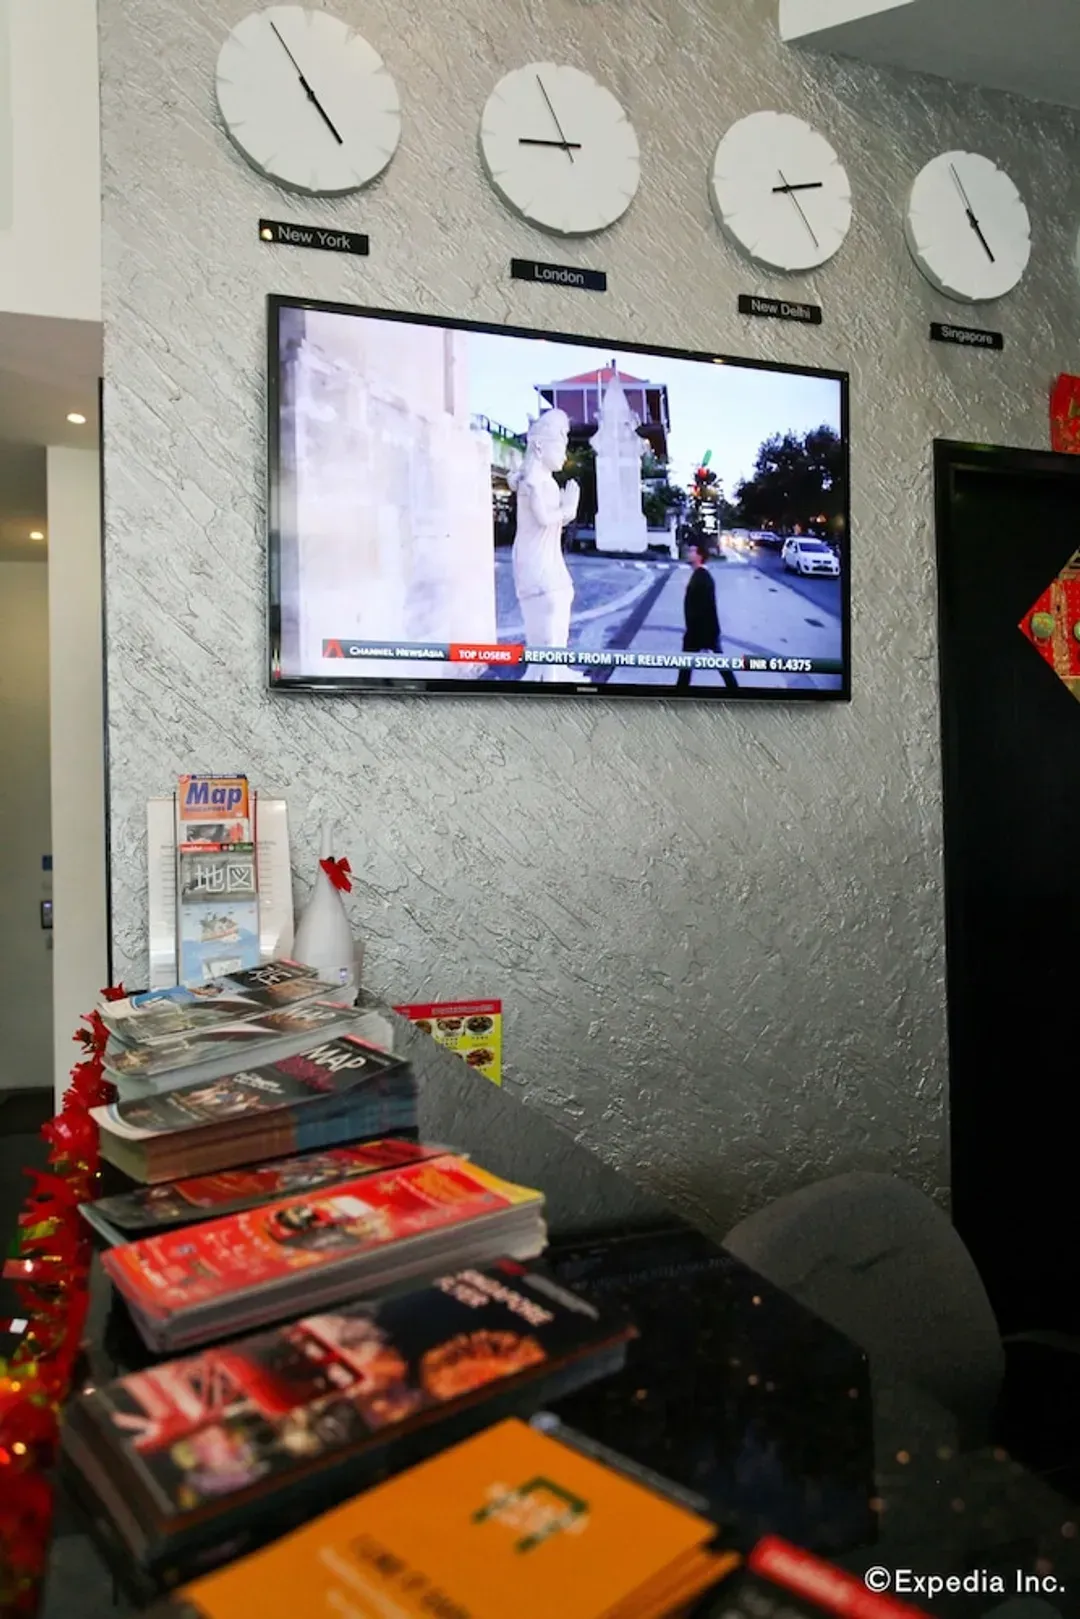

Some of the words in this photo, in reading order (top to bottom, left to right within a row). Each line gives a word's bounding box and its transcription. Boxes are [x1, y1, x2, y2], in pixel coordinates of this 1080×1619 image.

[278, 225, 313, 243] New
[317, 231, 351, 249] York
[534, 265, 584, 285] London
[751, 299, 778, 314] New
[781, 304, 811, 320] Delhi
[941, 325, 993, 345] Singapore
[459, 649, 477, 659] TOP
[479, 651, 511, 661] LOSERS
[525, 652, 576, 663] REPORTS
[578, 654, 611, 665] FROM
[614, 654, 635, 665] THE
[638, 655, 692, 667] RELEVANT
[694, 657, 729, 669] STOCK
[750, 659, 767, 670] INR
[770, 658, 811, 671] 61.4375
[186, 782, 242, 811] Map
[194, 863, 254, 893] 地图
[299, 1043, 367, 1073] MAP
